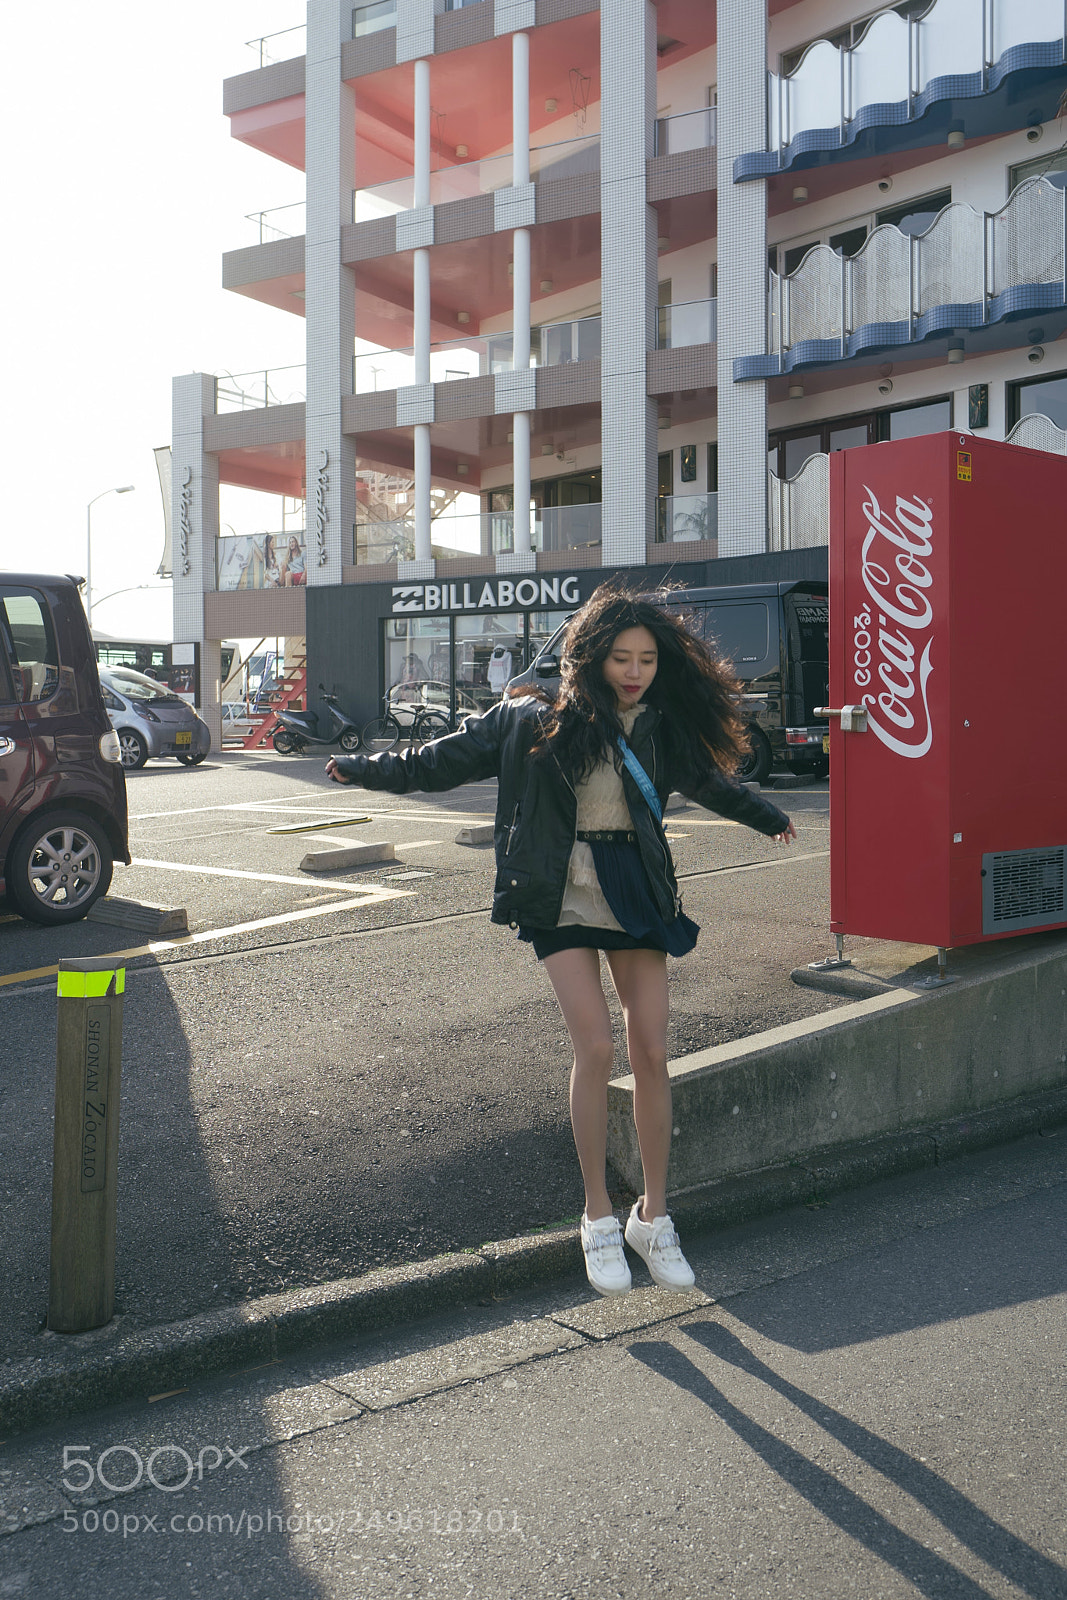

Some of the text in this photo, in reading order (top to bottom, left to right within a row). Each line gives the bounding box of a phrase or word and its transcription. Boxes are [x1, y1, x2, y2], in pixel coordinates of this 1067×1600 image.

[425, 576, 580, 611] BILLABONG
[861, 484, 934, 758] Coca-Cola
[86, 1020, 100, 1093] SHONAN
